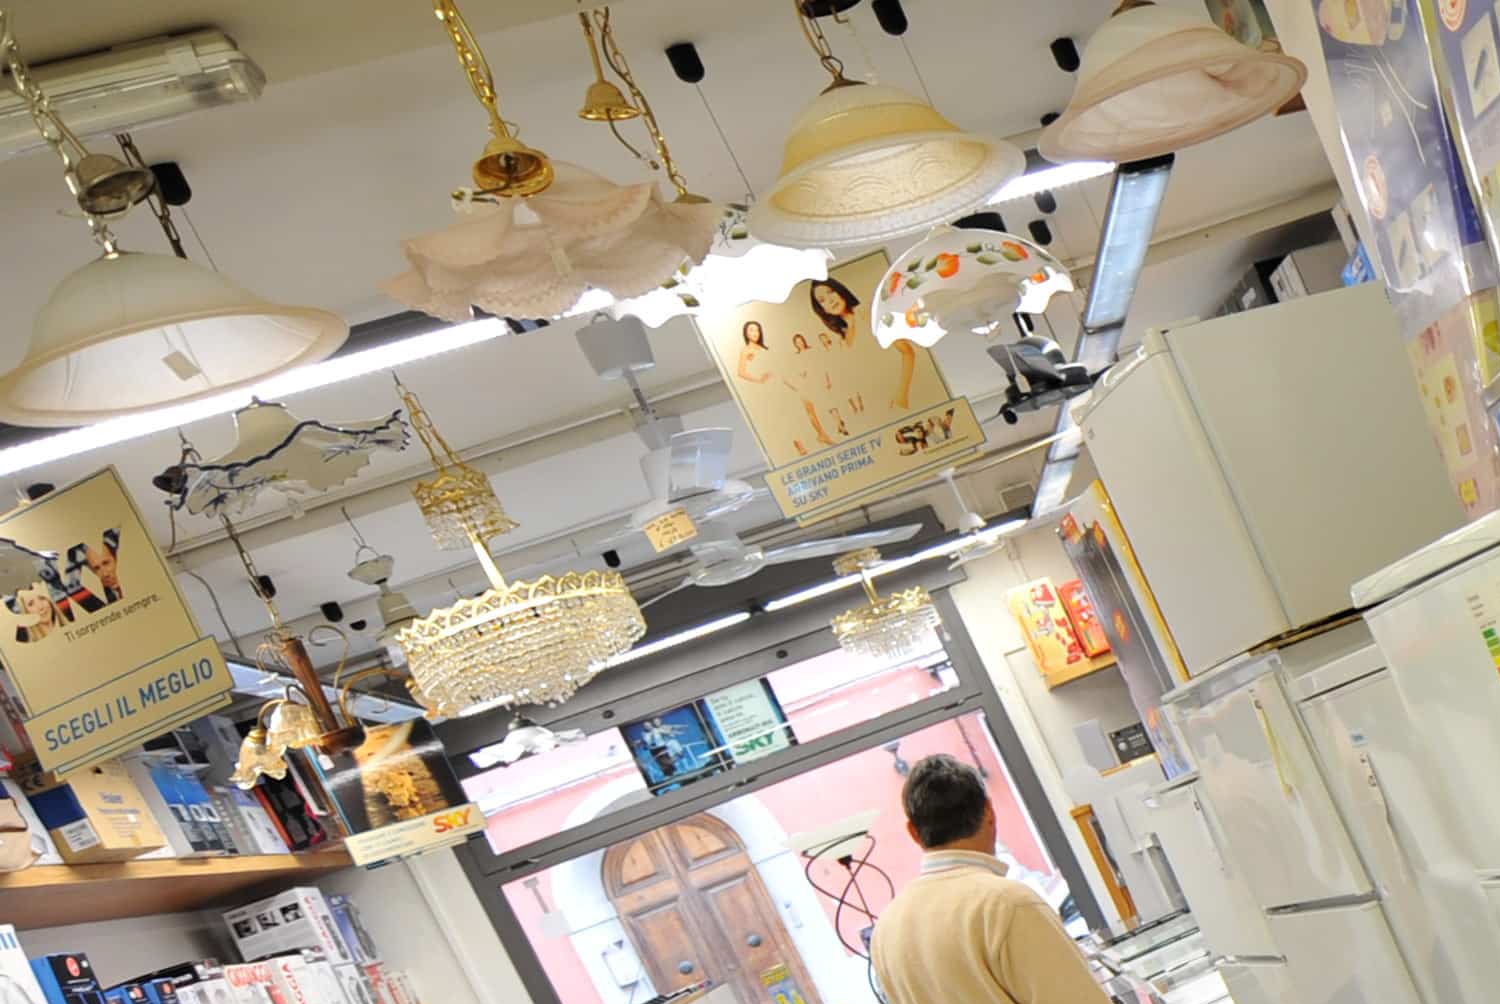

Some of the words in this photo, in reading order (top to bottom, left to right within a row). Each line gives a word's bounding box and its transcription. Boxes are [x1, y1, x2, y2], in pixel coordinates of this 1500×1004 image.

[895, 408, 955, 457] SKY
[781, 471, 794, 485] LE
[796, 456, 836, 481] GRANDI
[838, 445, 869, 463] SERIE
[869, 437, 882, 452] TV
[841, 455, 875, 475] PRIMA
[792, 493, 807, 508] SU
[810, 487, 829, 501] SKY
[64, 629, 77, 643] Ti
[75, 609, 122, 640] sorprende
[45, 703, 112, 751] SCEGLI
[116, 695, 136, 719] IL
[139, 658, 213, 708] MEGLIO
[433, 806, 472, 833] SKY
